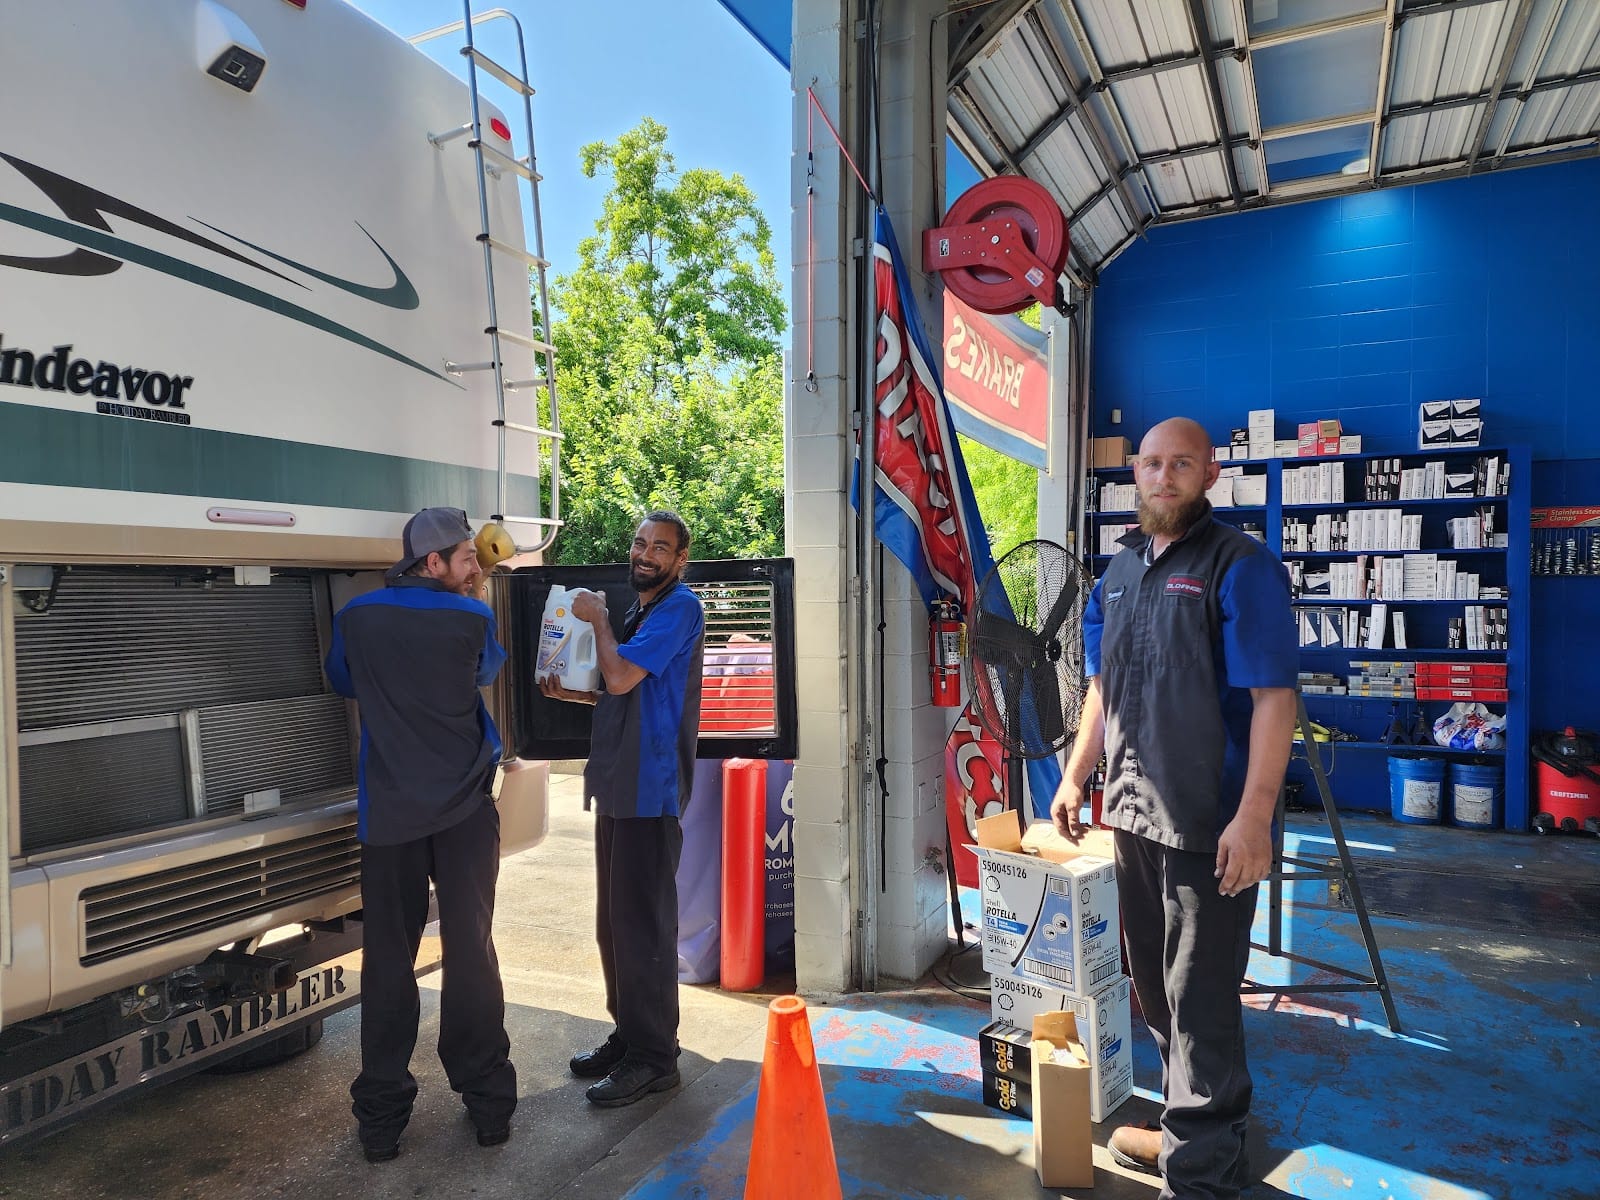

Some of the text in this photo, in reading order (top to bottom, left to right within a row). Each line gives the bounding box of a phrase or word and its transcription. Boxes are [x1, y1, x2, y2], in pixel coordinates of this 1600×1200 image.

[0, 333, 194, 408] ndeavor
[109, 403, 148, 419] HOLIDAY
[150, 409, 189, 424] RAMBLER
[765, 820, 794, 853] M
[764, 856, 794, 870] ROM
[982, 860, 1027, 880] 550045126
[782, 882, 795, 890] an
[986, 906, 1017, 921] ROTELLA
[987, 917, 996, 926] T4
[995, 977, 1043, 999] 550045126
[140, 964, 347, 1074] RAMBLER
[996, 1041, 1008, 1073] Gold
[998, 1077, 1011, 1111] Gold
